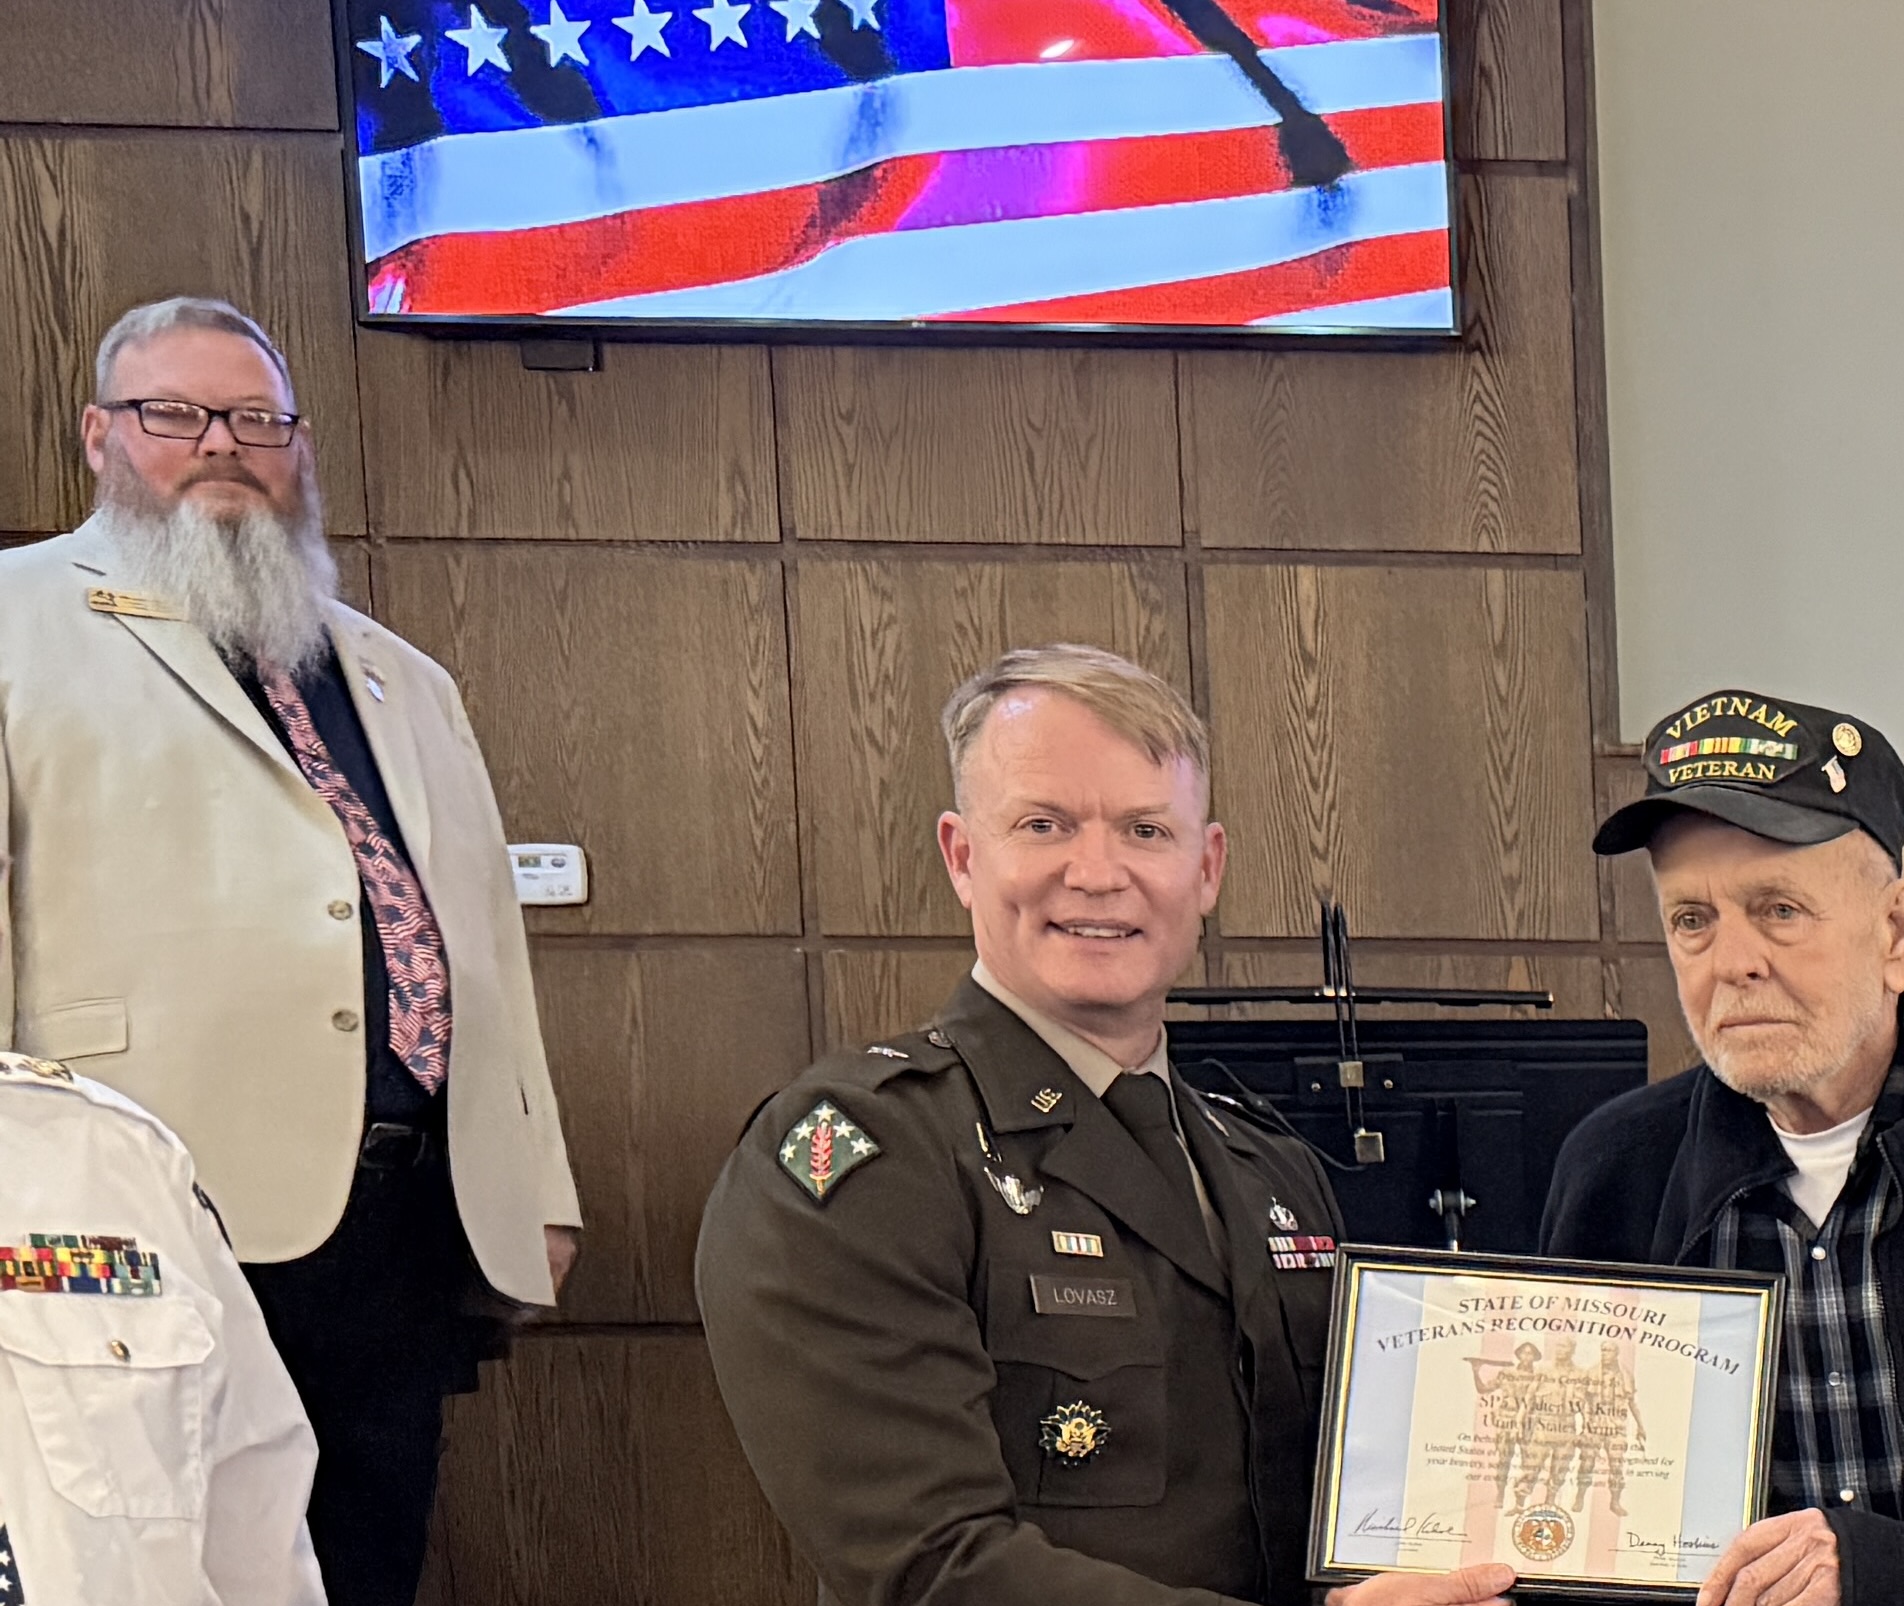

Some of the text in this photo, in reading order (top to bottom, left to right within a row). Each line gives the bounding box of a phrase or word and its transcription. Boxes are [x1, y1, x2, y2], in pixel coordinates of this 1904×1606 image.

[1666, 697, 1798, 739] VIETNAM
[1668, 760, 1776, 784] VETERAN
[1053, 1287, 1118, 1306] LOVASZ
[1458, 1295, 1668, 1327] STATE OF MISSOURI
[1376, 1317, 1740, 1376] VETERANS RECOGNITION PROGRAM
